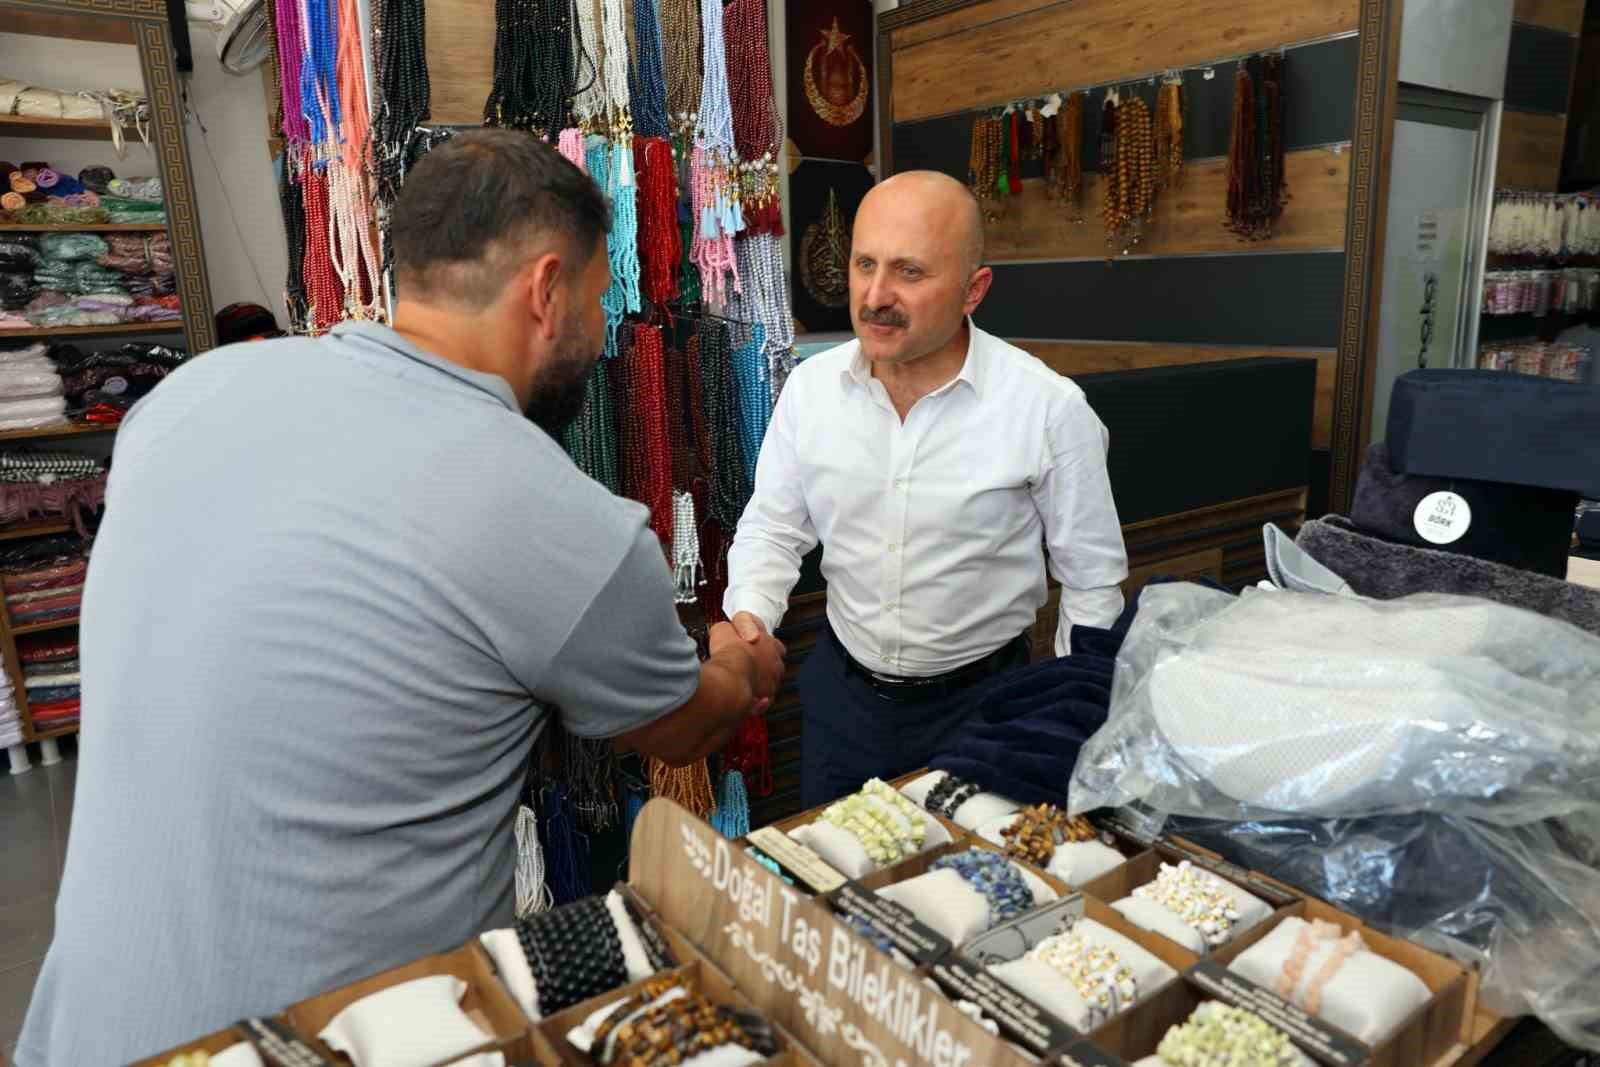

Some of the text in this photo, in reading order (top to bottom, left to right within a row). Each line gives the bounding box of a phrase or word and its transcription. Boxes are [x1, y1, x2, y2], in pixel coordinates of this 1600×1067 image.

[713, 838, 772, 928] Doğal
[780, 886, 821, 976] Taş
[828, 927, 972, 1067] Bileklikler
